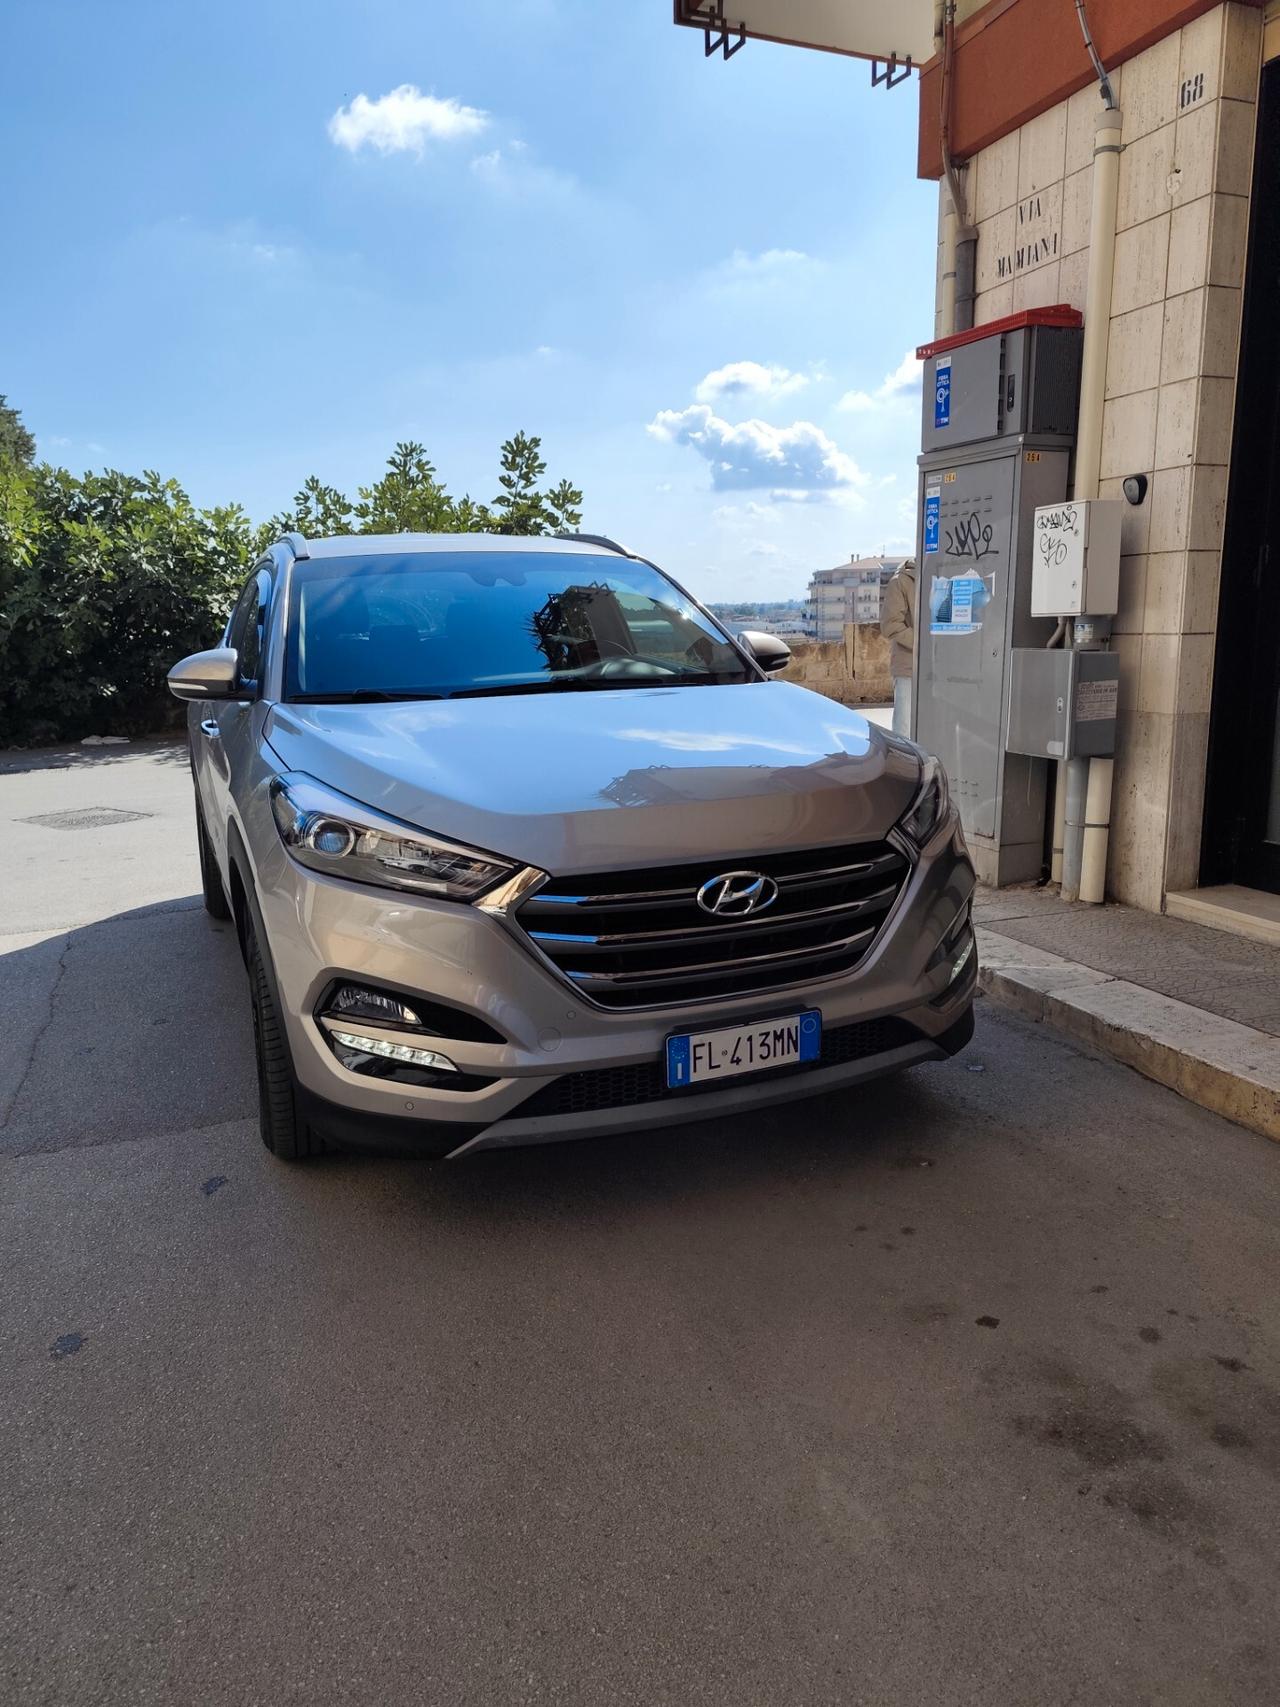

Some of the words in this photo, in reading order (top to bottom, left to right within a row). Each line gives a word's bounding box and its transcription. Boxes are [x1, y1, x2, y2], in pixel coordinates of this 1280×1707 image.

[1181, 73, 1204, 109] 68
[1019, 197, 1041, 225] VIA
[997, 232, 1058, 278] MAMIANI
[692, 1041, 721, 1074] FL
[729, 1025, 800, 1066] 413MN
